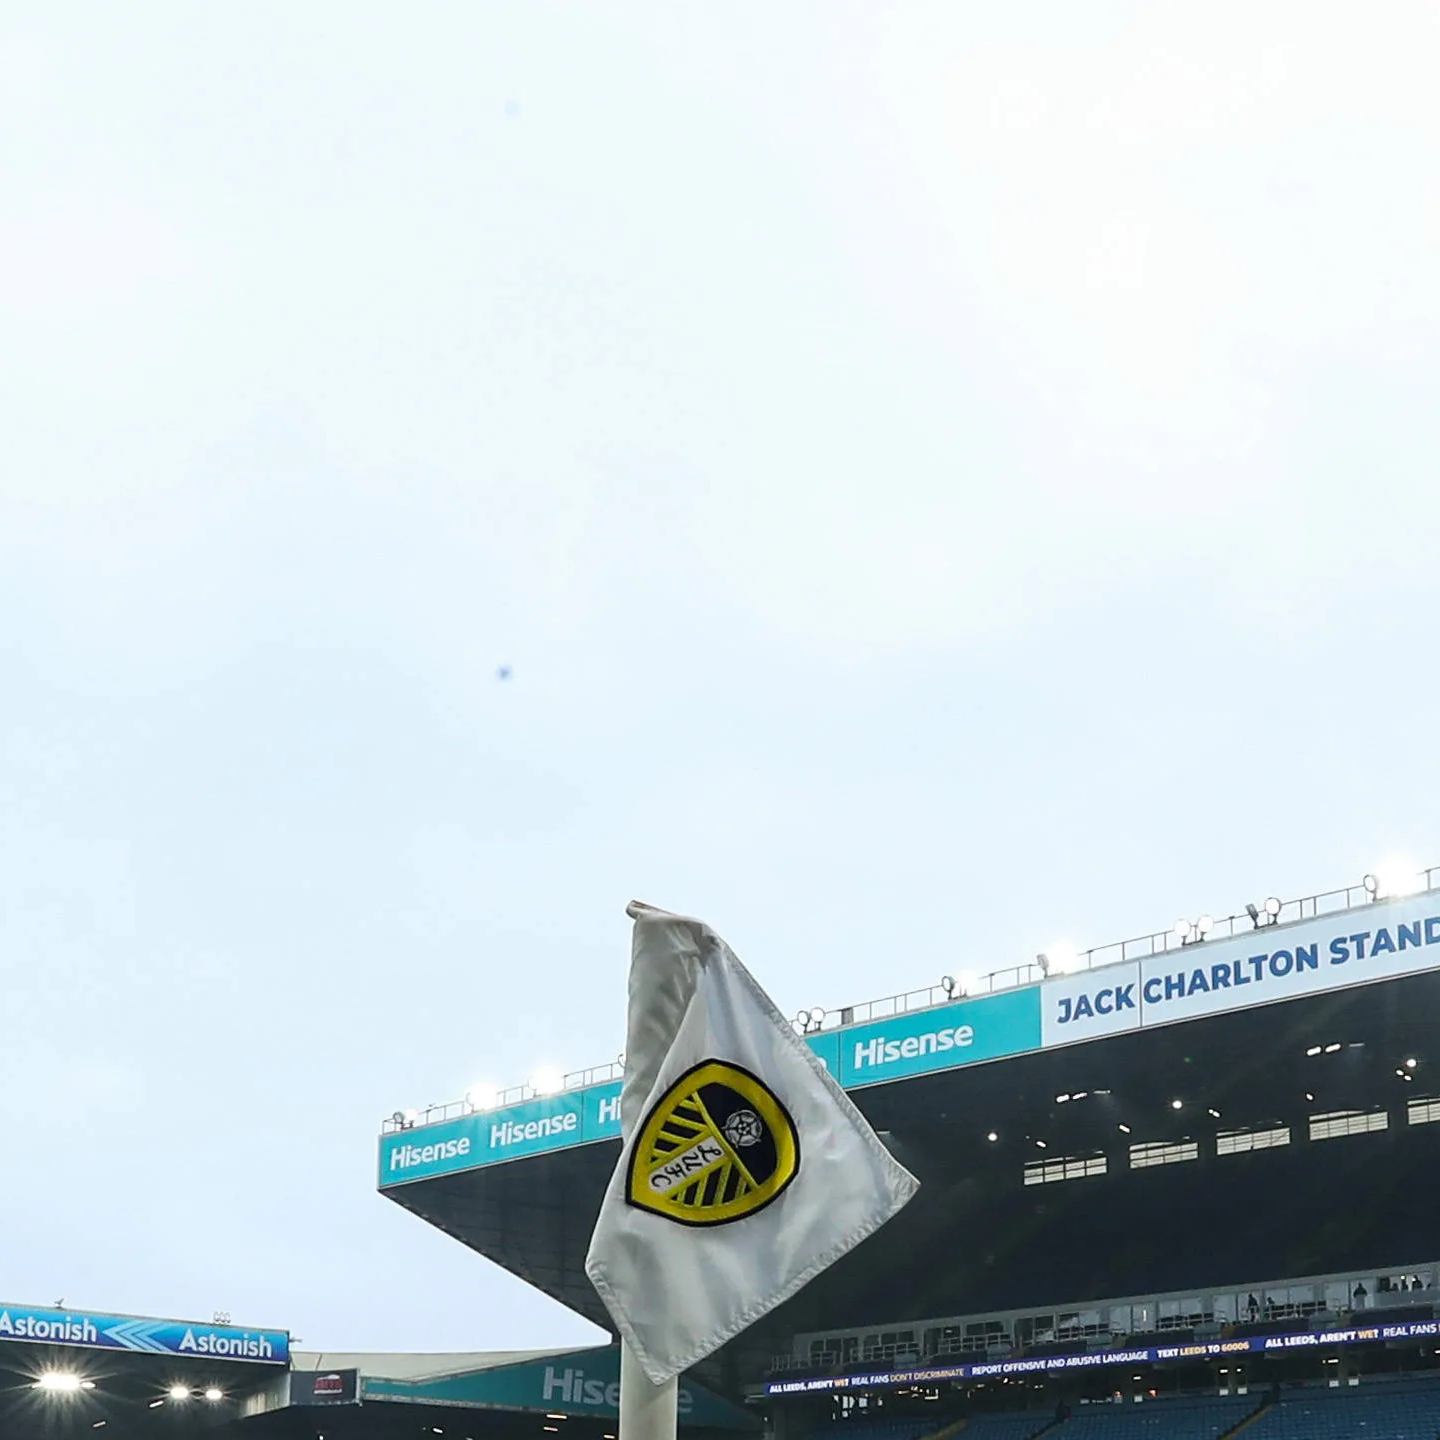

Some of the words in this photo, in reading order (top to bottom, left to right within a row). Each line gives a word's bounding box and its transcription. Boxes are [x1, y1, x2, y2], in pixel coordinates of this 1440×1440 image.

[1057, 982, 1136, 1026] JACK
[1142, 942, 1320, 1005] CHARLTON
[853, 1022, 974, 1070] Hisense
[490, 1111, 577, 1149] Hisense
[390, 1136, 470, 1171] Hisense
[178, 1327, 272, 1358] Astonish
[1158, 1348, 1178, 1358] TEXT
[1180, 1346, 1206, 1355] LEEDS
[1208, 1345, 1220, 1353] TO
[1221, 1341, 1249, 1352] 60006
[1266, 1338, 1283, 1348] ALL
[1285, 1335, 1318, 1346] LEEDS,
[1320, 1331, 1356, 1343] AREN'T
[1358, 1329, 1378, 1339] WE?
[1383, 1327, 1408, 1336] REAL
[1410, 1324, 1436, 1334] FANS
[972, 1365, 1004, 1375] REPORT
[1003, 1360, 1045, 1372] OFFENSIVE
[1047, 1359, 1067, 1368] AND
[1066, 1355, 1101, 1366] ABUSIVE
[1103, 1351, 1147, 1363] LANGUAGE
